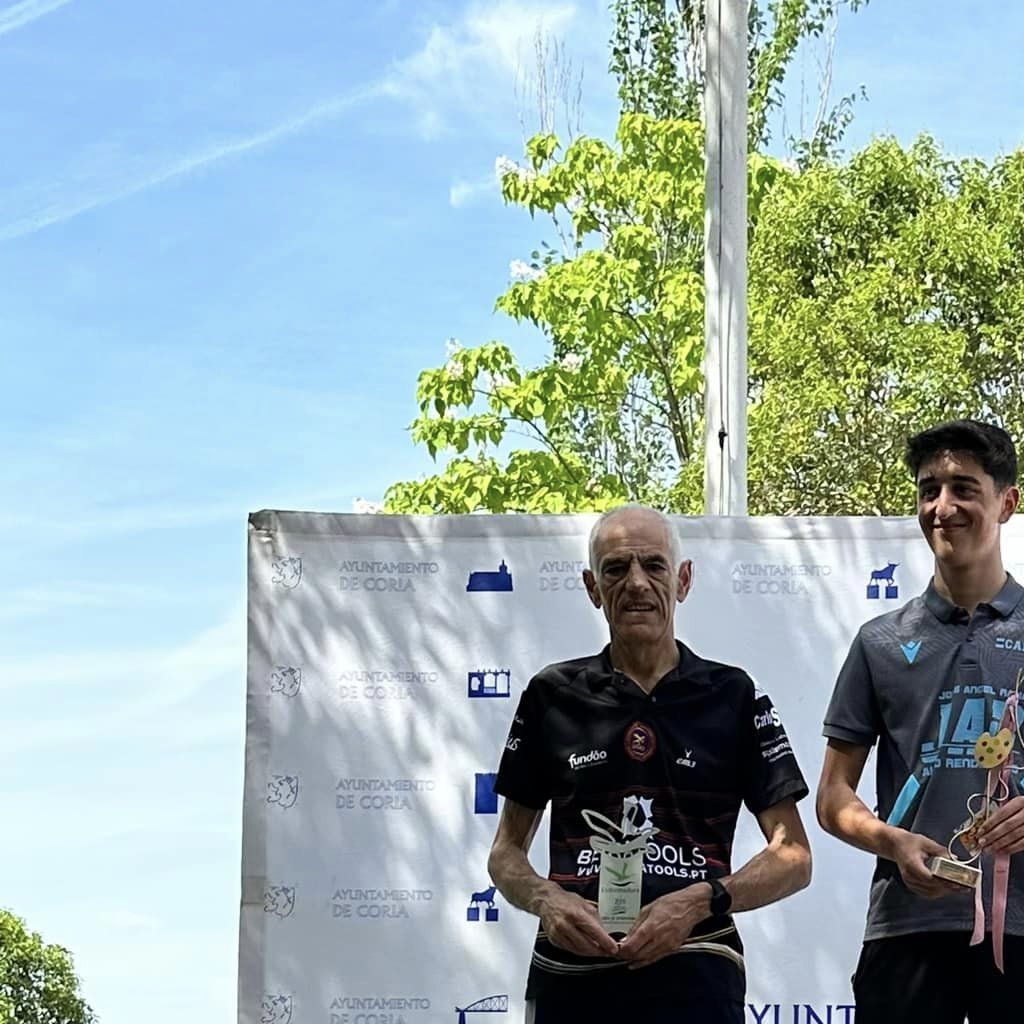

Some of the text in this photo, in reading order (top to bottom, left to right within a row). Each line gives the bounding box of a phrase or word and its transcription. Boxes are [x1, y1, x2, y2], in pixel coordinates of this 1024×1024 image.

[339, 560, 440, 574] AYUNTAMIENTO
[732, 564, 832, 577] AYUNTAMIENTO
[339, 577, 416, 592] DE CORIA
[732, 580, 809, 595] DE CORIA
[336, 779, 436, 792] AYUNTAMIENTO
[336, 795, 413, 810] DE CORIA
[332, 889, 433, 901] AYUNTAMIENTO
[332, 904, 410, 919] DE CORIA
[330, 998, 430, 1010] AYUNTAMIENTO
